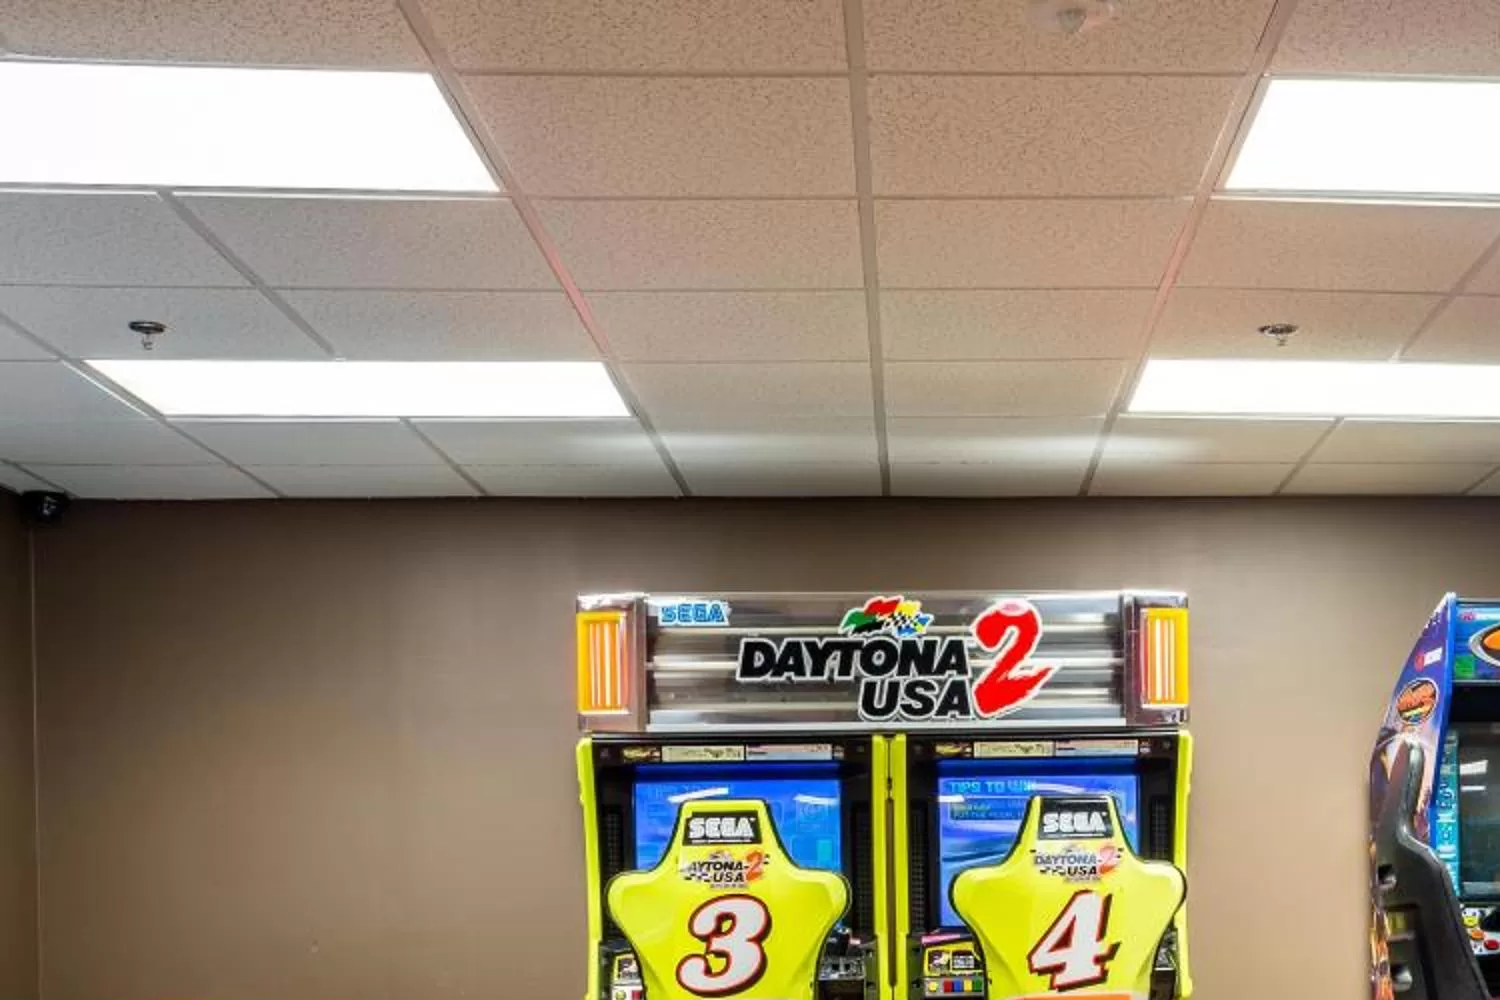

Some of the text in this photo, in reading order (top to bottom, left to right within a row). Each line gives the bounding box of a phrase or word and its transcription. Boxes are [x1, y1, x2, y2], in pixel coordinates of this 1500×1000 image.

[661, 602, 728, 625] SEGA
[737, 599, 1058, 718] DAYTONA 2
[858, 678, 973, 720] USA
[689, 817, 755, 839] SEGA
[1043, 811, 1106, 833] SEGA
[713, 872, 745, 883] USA
[676, 894, 772, 997] 3
[1028, 889, 1121, 991] 4
